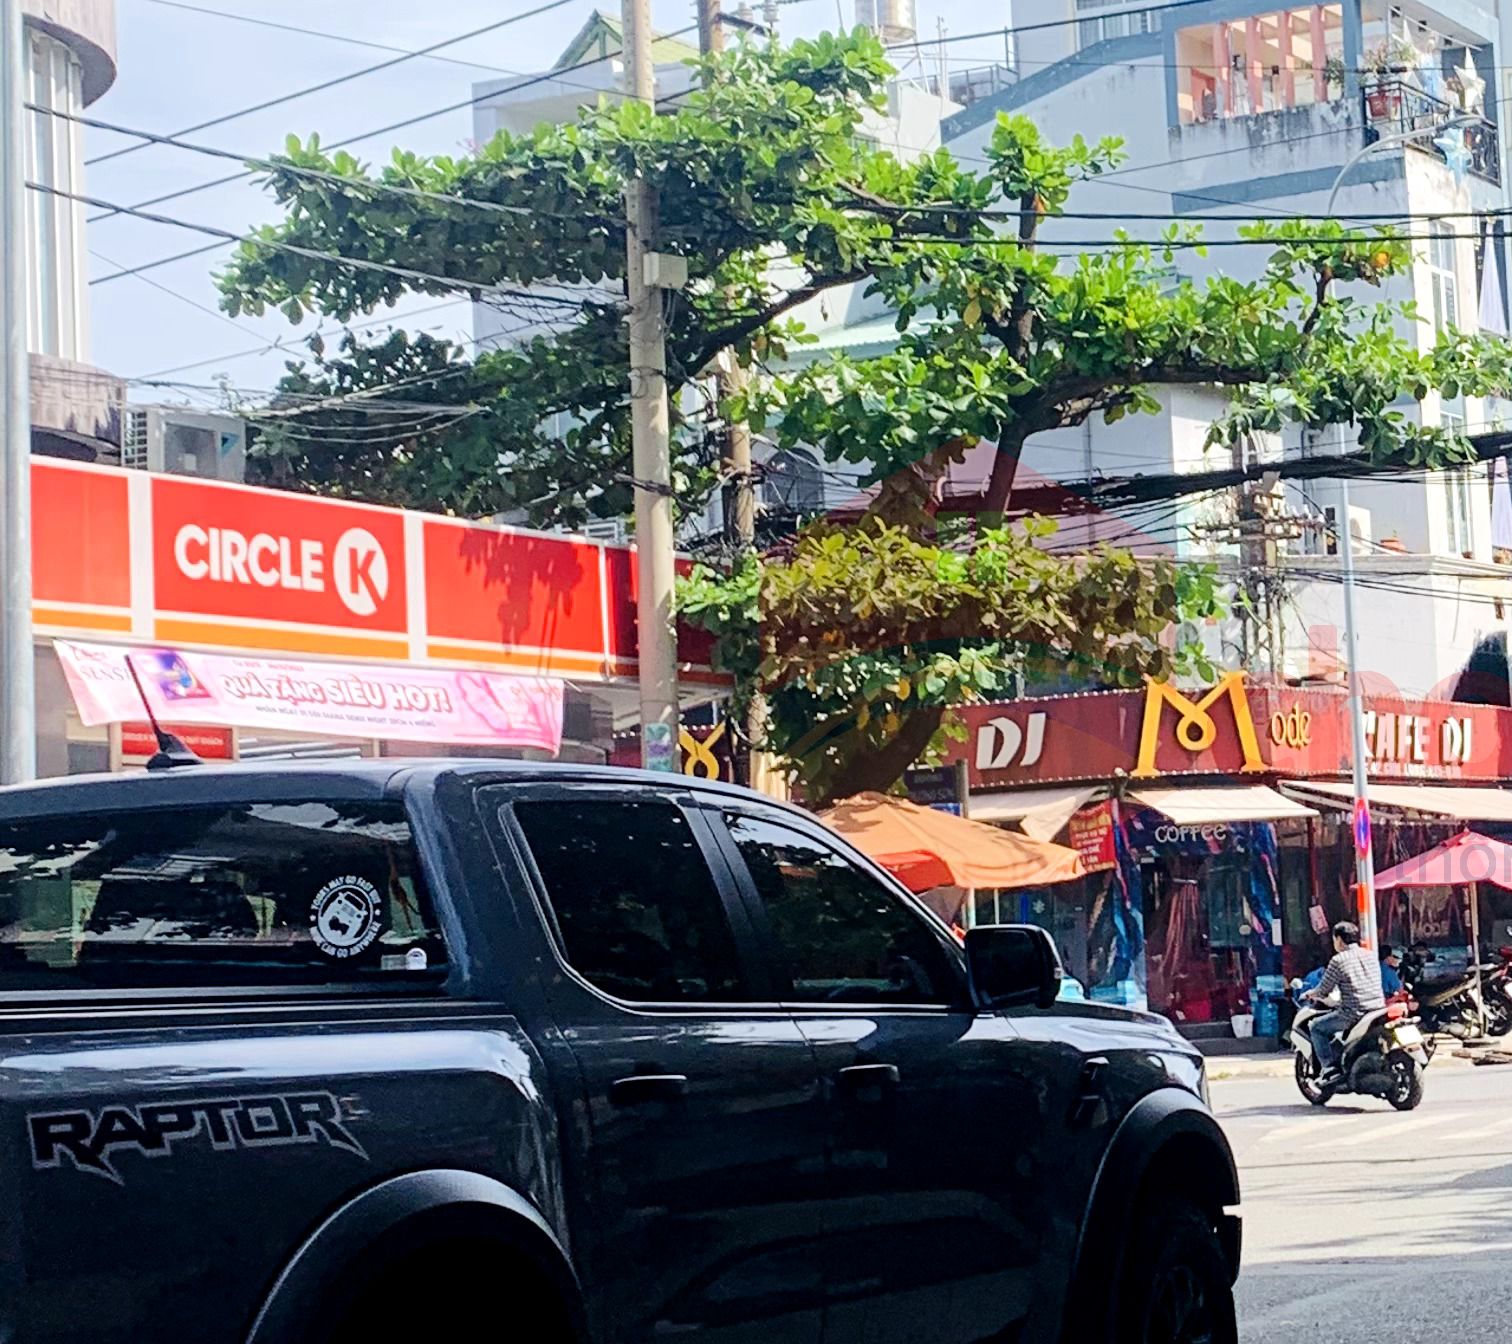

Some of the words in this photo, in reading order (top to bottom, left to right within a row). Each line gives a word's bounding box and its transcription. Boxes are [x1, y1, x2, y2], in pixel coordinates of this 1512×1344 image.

[174, 522, 325, 593] CIRCLE
[338, 532, 389, 610] K
[222, 671, 271, 700] QUÀ
[269, 675, 323, 706] TẶNG
[325, 673, 386, 709] SIÊU
[385, 682, 453, 714] HOT!
[976, 711, 1047, 770] DJ
[26, 1090, 370, 1185] RAPTOR
